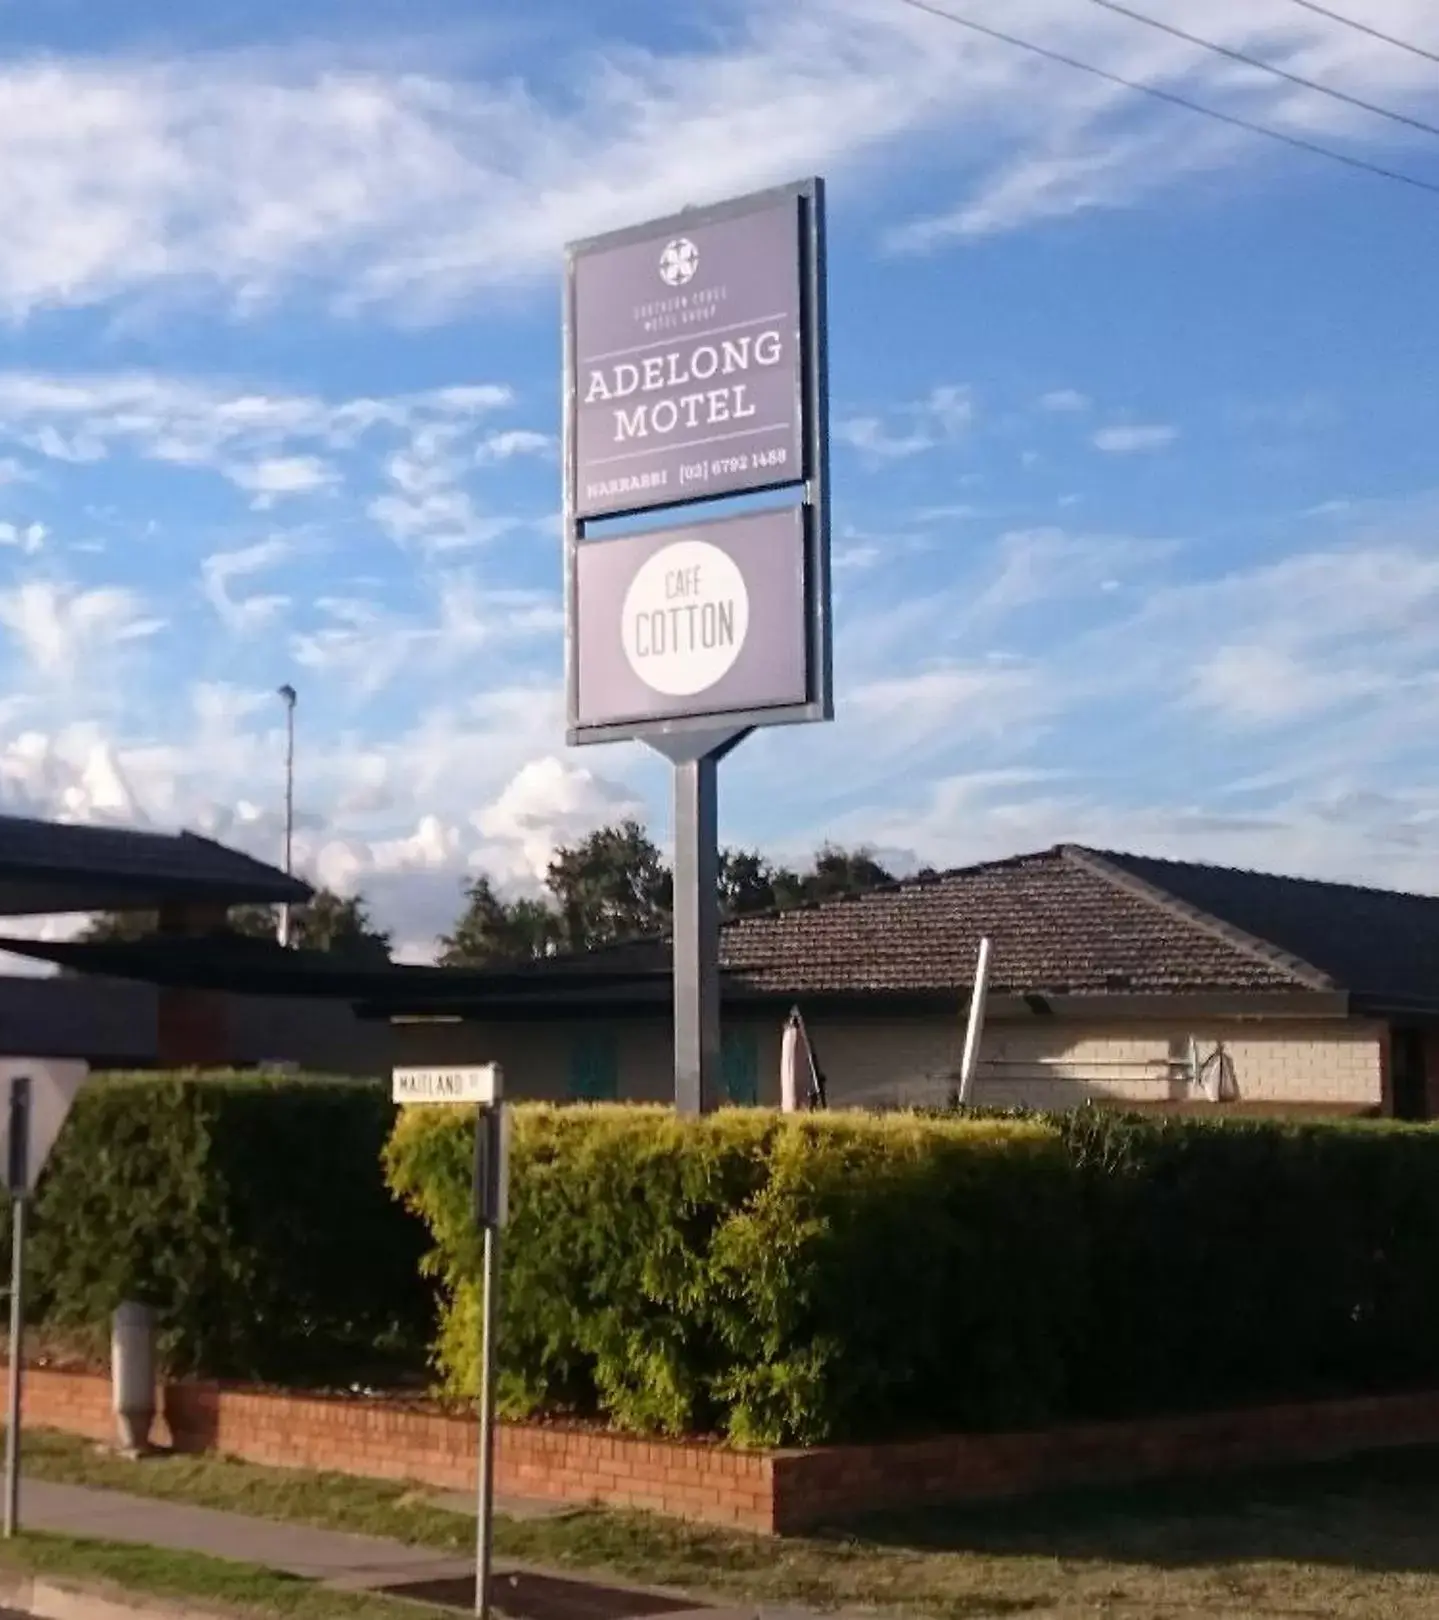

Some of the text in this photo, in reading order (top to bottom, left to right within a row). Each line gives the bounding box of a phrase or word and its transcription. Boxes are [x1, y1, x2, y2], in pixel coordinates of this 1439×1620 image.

[584, 331, 782, 402] ADELONG
[613, 384, 755, 441] MOTEL
[636, 600, 734, 657] COTTON
[400, 1073, 463, 1096] MAITLAND
